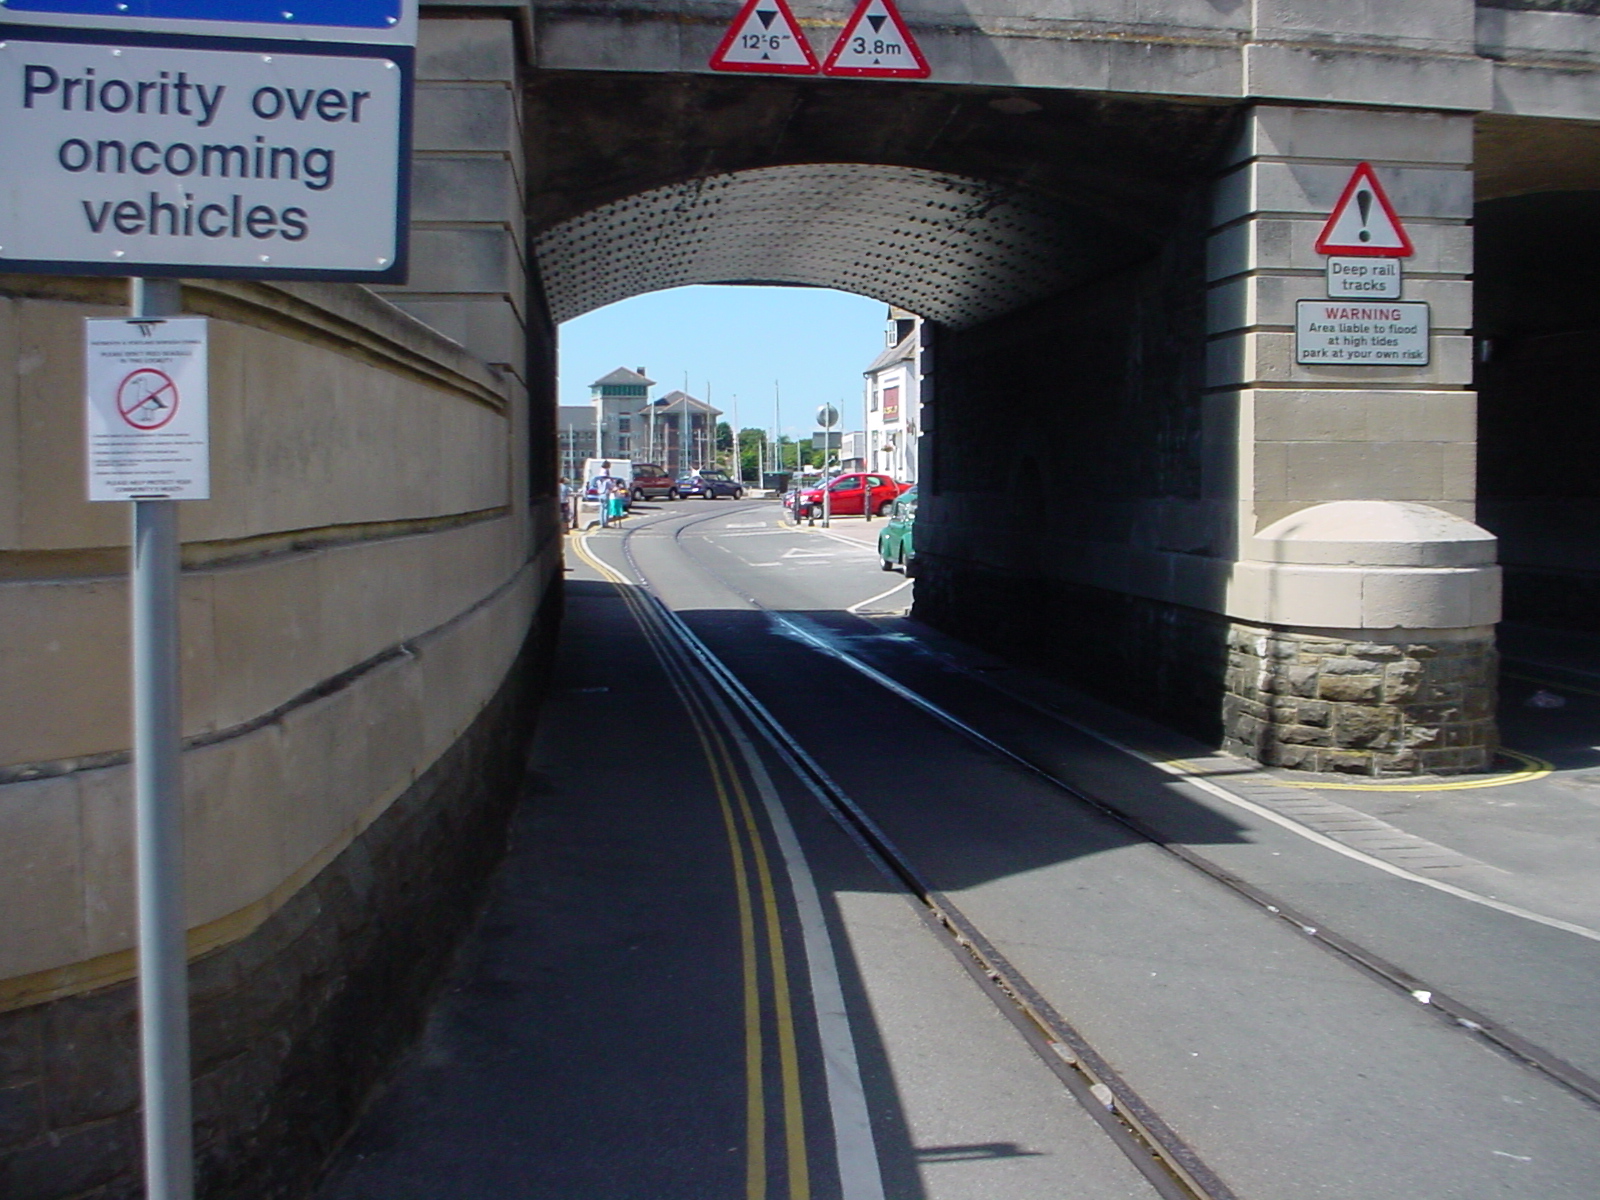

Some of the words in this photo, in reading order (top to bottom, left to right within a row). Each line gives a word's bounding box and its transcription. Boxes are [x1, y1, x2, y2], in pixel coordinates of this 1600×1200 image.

[852, 37, 902, 55] 3.8m
[23, 64, 227, 127] Priority
[251, 85, 371, 123] over
[58, 135, 335, 191] oncoming
[82, 191, 309, 242] vehicles
[1332, 263, 1368, 277] Deep
[1373, 264, 1396, 276] rail
[1342, 280, 1387, 291] tracks
[1325, 308, 1402, 321] WARNING
[1309, 322, 1336, 333] Area
[1340, 323, 1370, 334] liable
[1374, 324, 1386, 334] to
[1389, 324, 1418, 334] flood
[1328, 337, 1340, 345] at
[1343, 336, 1368, 347] high
[1372, 336, 1399, 346] tides
[1303, 348, 1329, 358] park
[1332, 349, 1343, 358] at
[1347, 350, 1372, 360] your
[1402, 350, 1424, 359] risk
